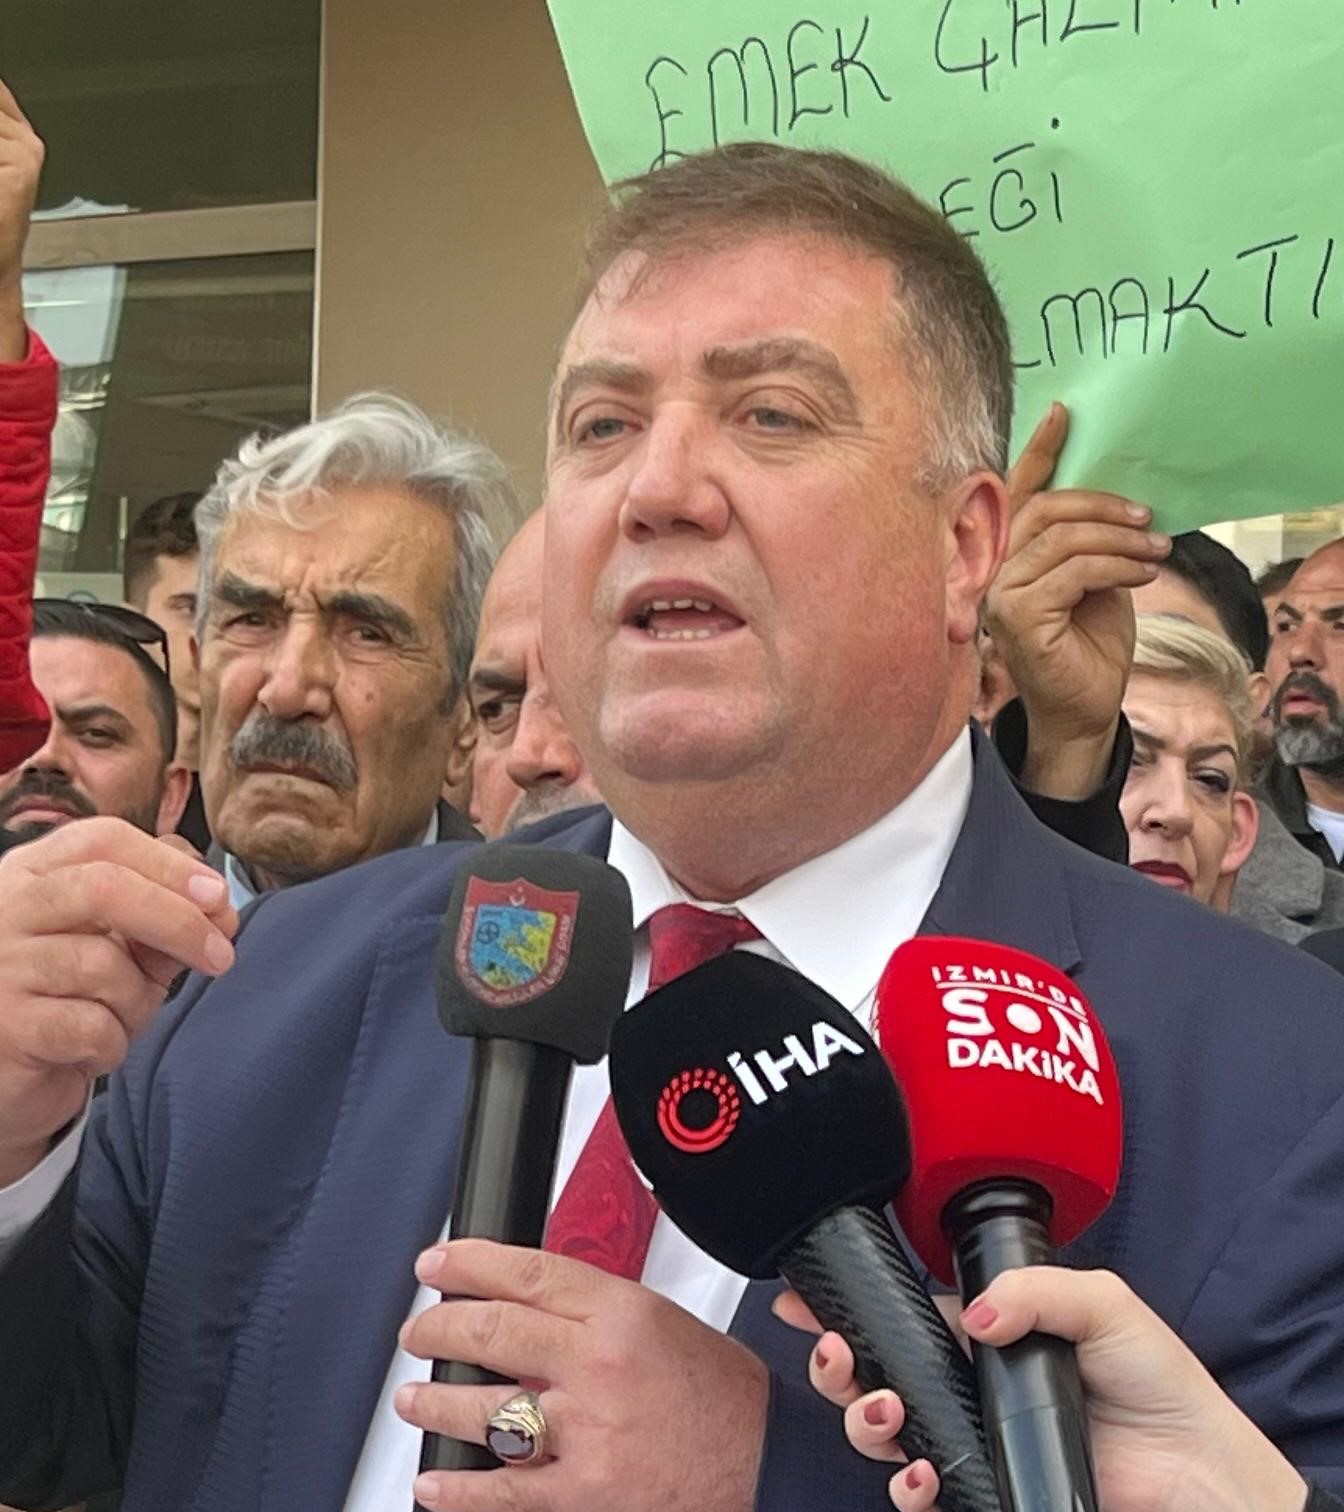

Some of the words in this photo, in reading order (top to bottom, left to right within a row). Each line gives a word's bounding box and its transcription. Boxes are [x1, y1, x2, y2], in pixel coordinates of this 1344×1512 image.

[645, 15, 892, 175] EMEK
[940, 117, 1063, 237] EĞİ
[725, 1020, 866, 1106] İHA
